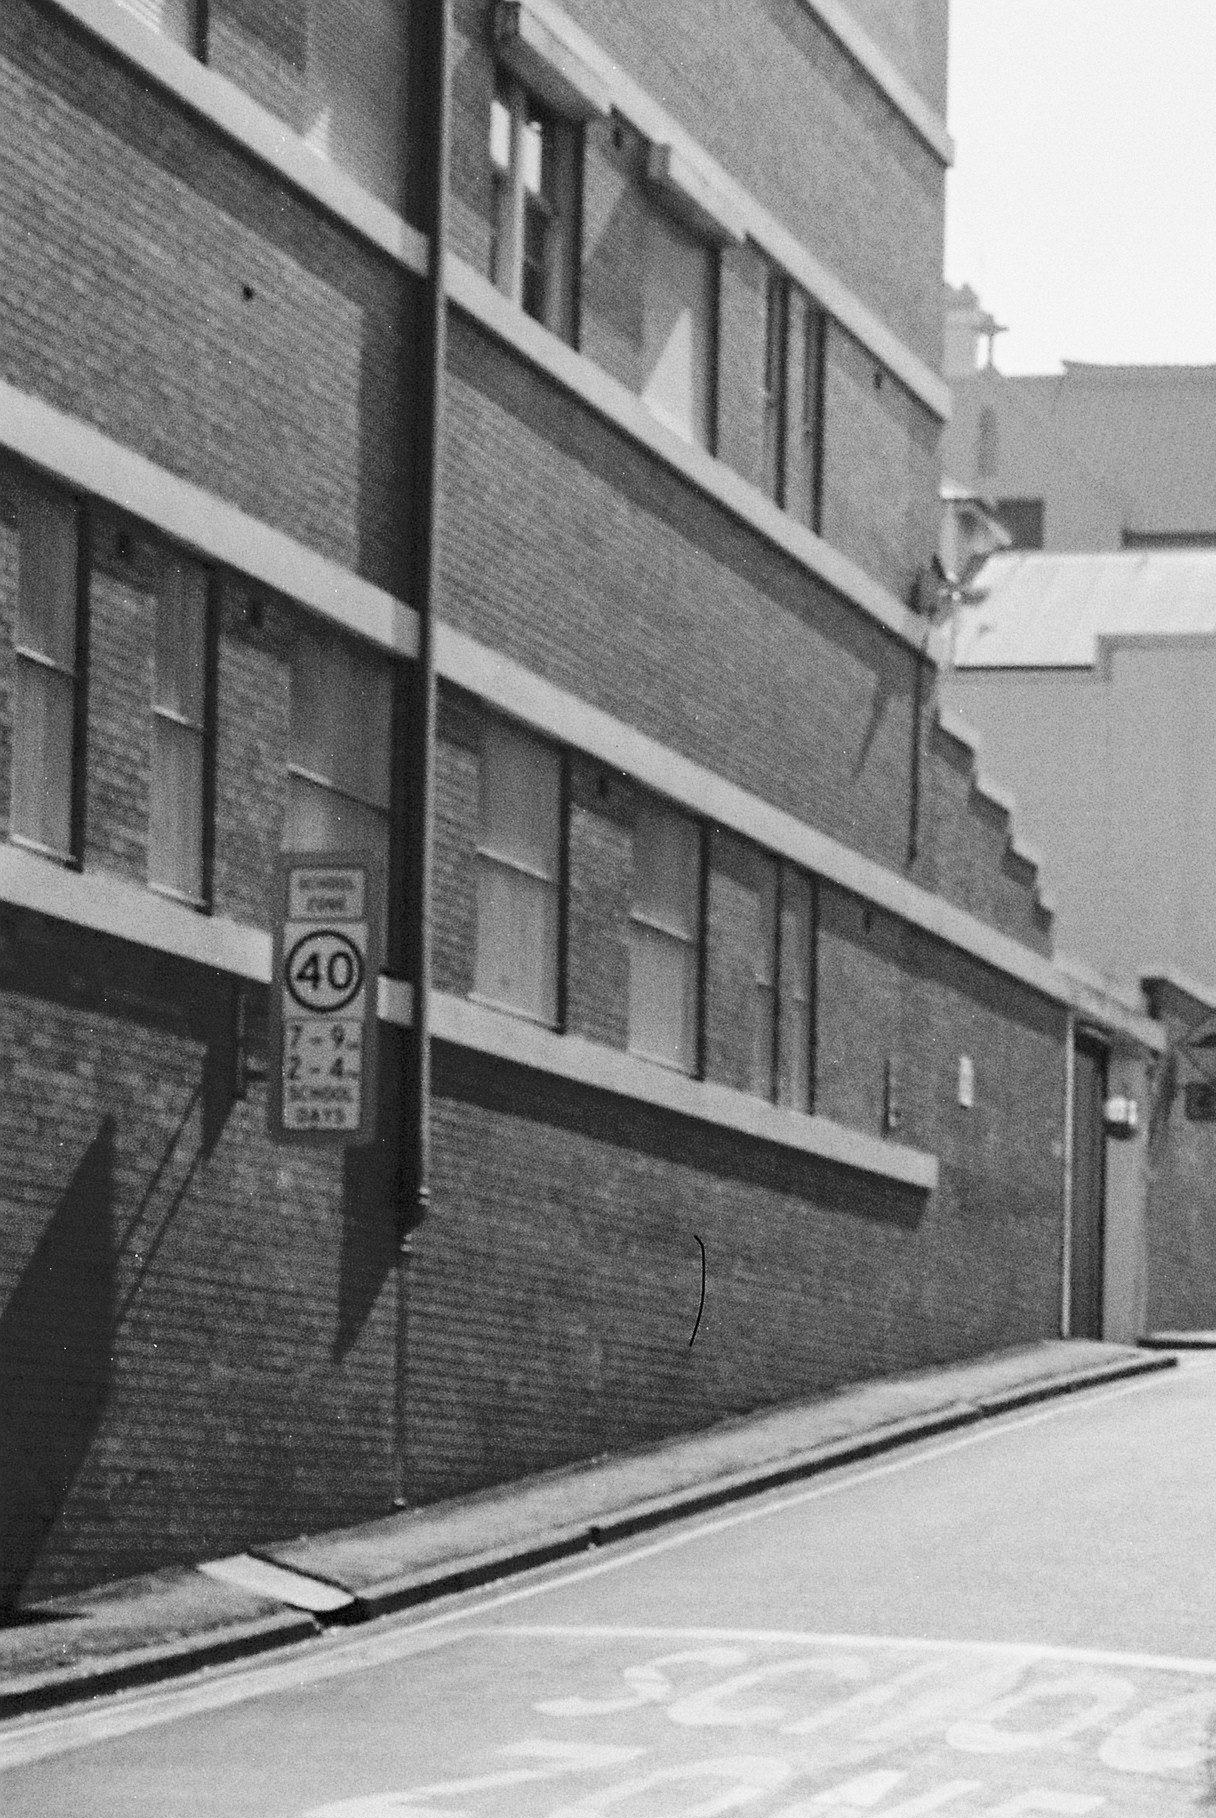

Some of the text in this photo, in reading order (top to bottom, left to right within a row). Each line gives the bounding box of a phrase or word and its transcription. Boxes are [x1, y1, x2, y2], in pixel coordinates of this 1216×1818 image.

[297, 951, 353, 991] 40
[289, 1086, 353, 1104] SCHOOL
[296, 1108, 346, 1124] DAYS
